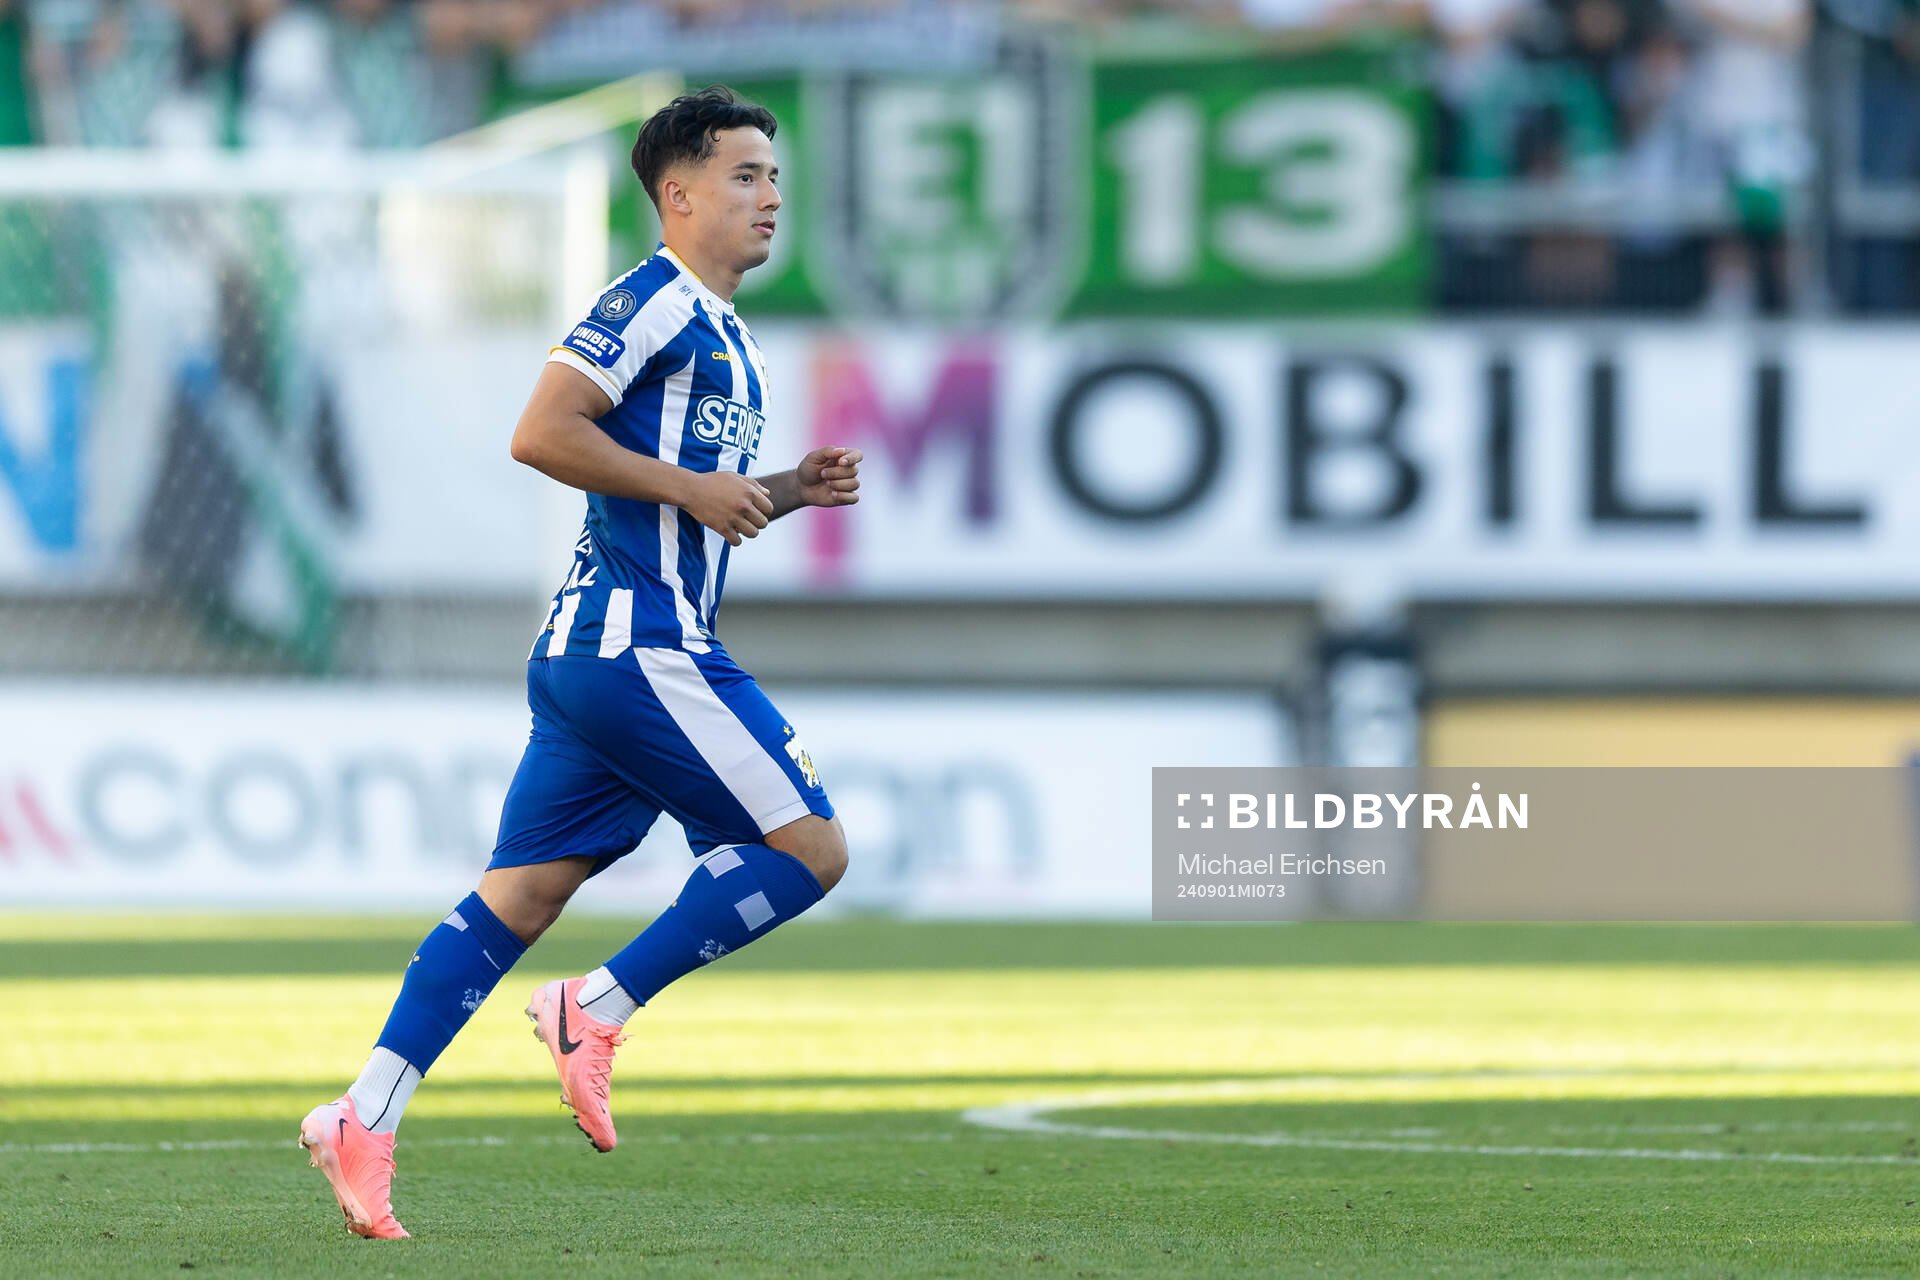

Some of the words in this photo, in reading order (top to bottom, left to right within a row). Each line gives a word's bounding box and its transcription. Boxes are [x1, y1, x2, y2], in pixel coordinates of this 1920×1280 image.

[1108, 92, 1416, 287] 13
[572, 326, 621, 356] UNIBET
[810, 345, 1870, 586] MOBILL
